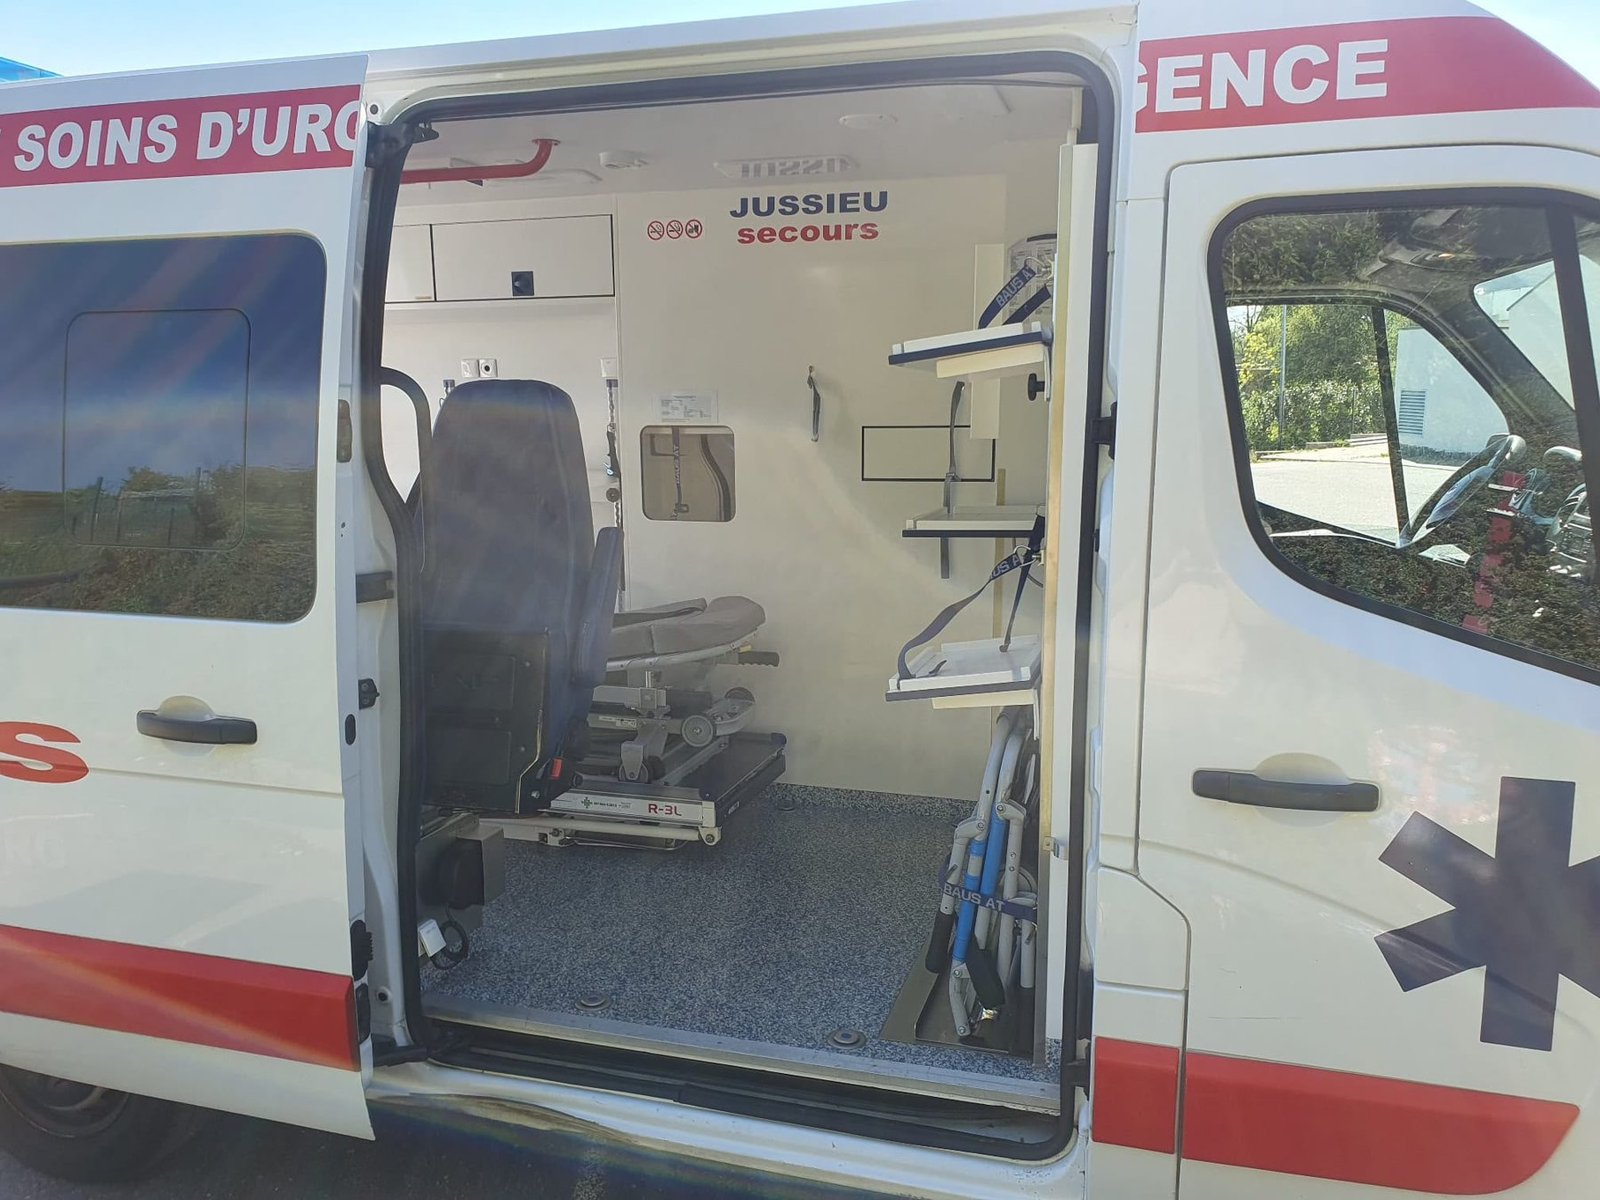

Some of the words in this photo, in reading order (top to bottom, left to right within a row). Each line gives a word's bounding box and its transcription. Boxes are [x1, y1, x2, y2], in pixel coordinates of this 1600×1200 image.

[1137, 38, 1389, 113] ENCE
[14, 114, 178, 171] SOINS
[729, 191, 888, 218] JUSSIEU
[737, 222, 879, 244] secours
[996, 277, 1024, 306] BAUS
[648, 803, 682, 816] R-3L
[943, 883, 982, 905] BAUS
[985, 897, 1006, 912] AT
